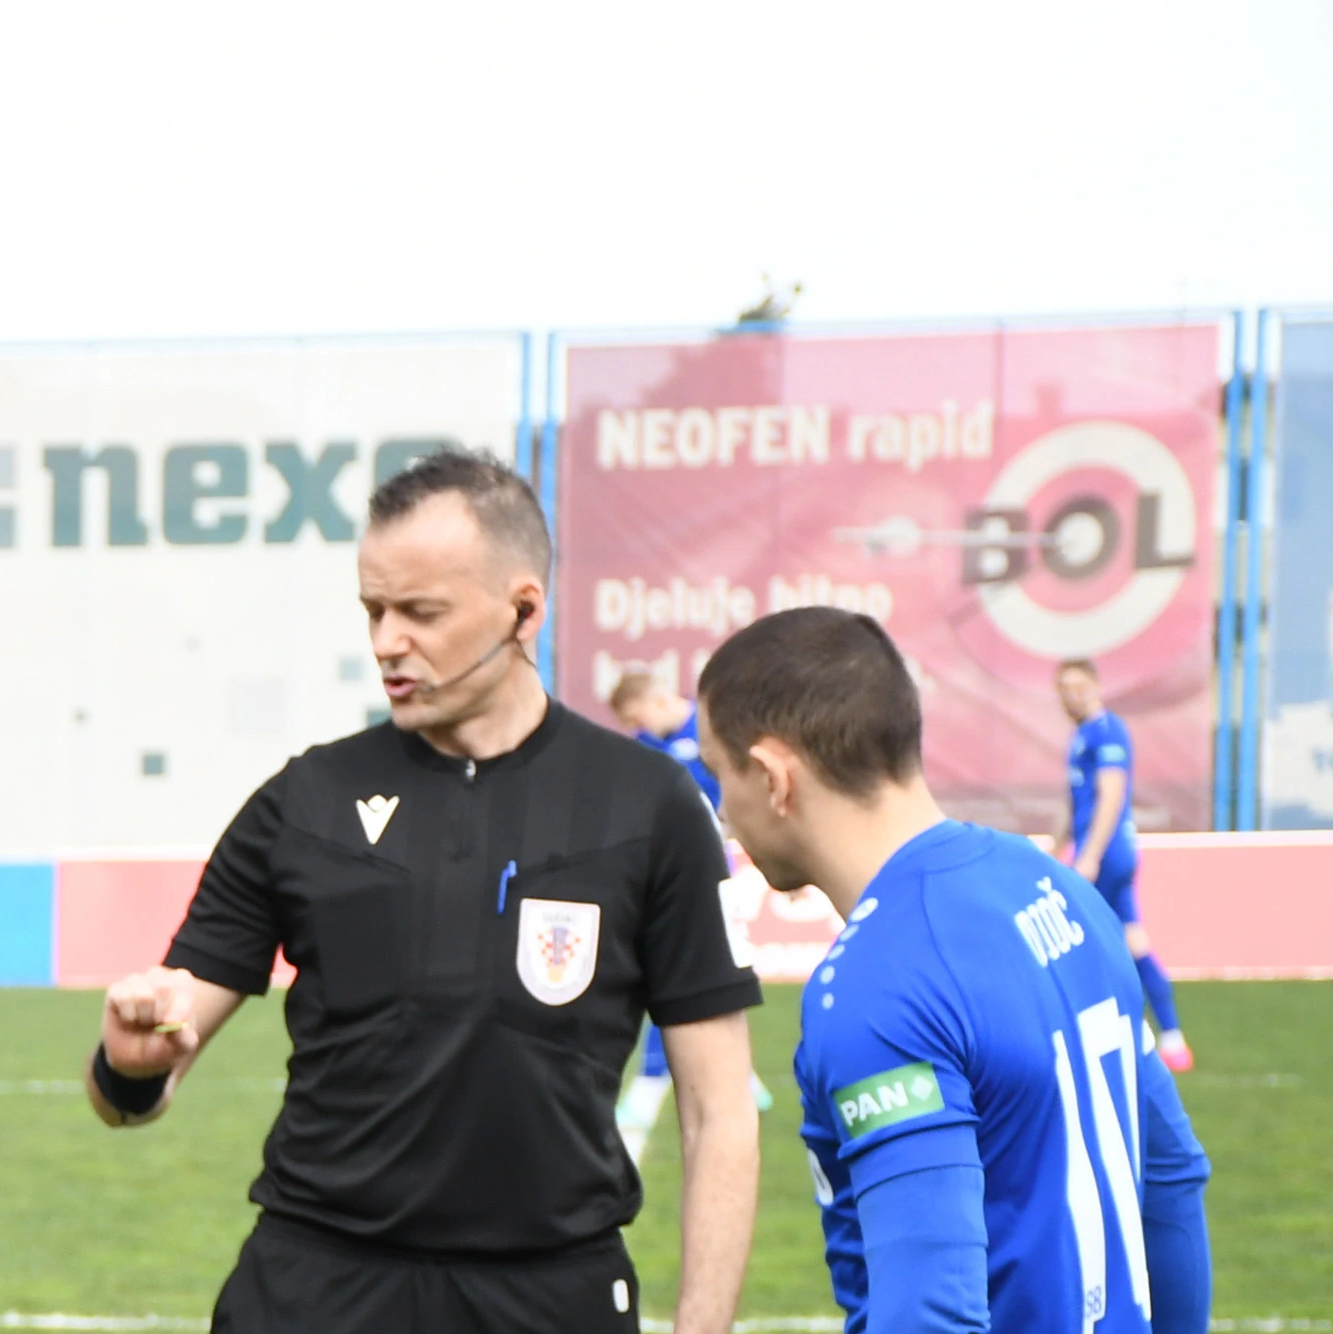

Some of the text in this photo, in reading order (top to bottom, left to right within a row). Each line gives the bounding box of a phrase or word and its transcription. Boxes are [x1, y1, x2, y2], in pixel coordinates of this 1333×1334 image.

[596, 398, 995, 471] NEOFEN rapid
[961, 492, 1195, 586] BOL
[840, 1080, 909, 1127] PAN
